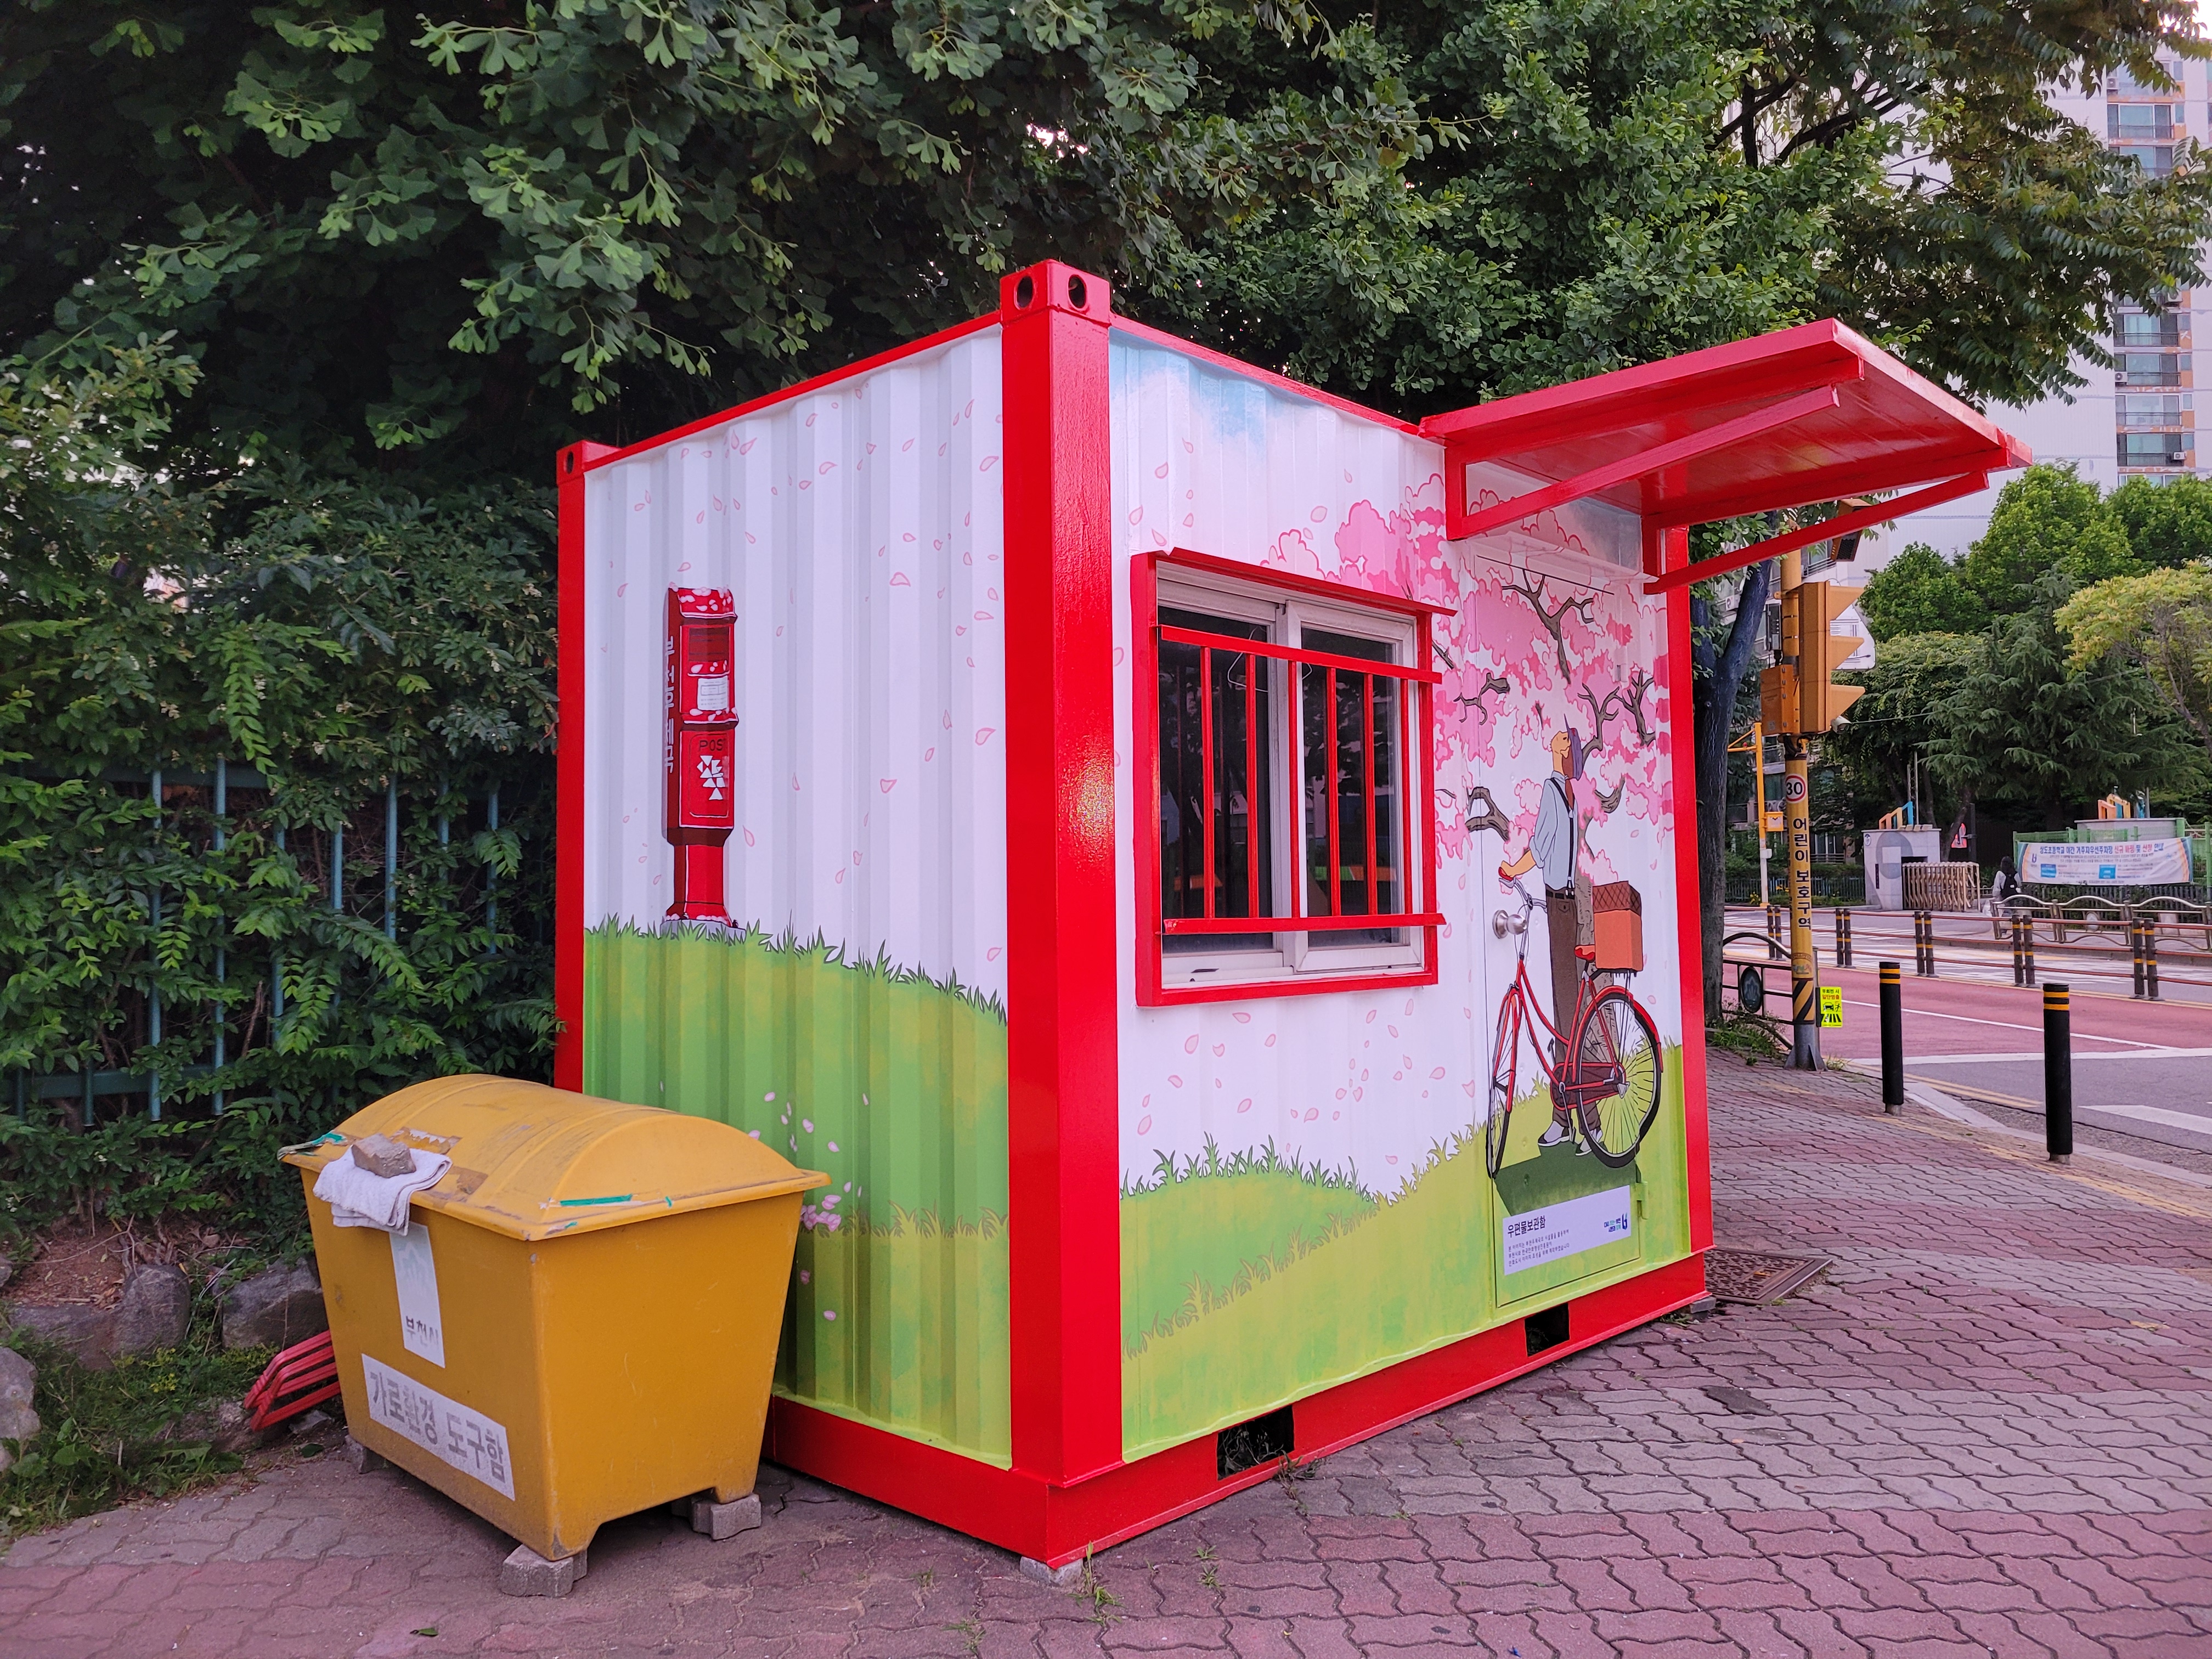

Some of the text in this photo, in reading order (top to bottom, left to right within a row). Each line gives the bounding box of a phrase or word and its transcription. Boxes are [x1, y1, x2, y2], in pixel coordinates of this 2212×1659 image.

[699, 738, 726, 751] POS
[1786, 782, 1803, 795] 30
[2040, 846, 2064, 854] 상도초등학교
[2076, 845, 2113, 854] 거주자우선주차장
[2114, 845, 2124, 854] 신규
[2125, 845, 2135, 853] 배정
[2136, 844, 2141, 853] 및
[1793, 817, 1811, 930] 어린이 보호구역
[1508, 1215, 1546, 1238] 우편물보관함
[406, 1316, 439, 1346] 부천시
[370, 1372, 505, 1483] 가로환경 도구함
